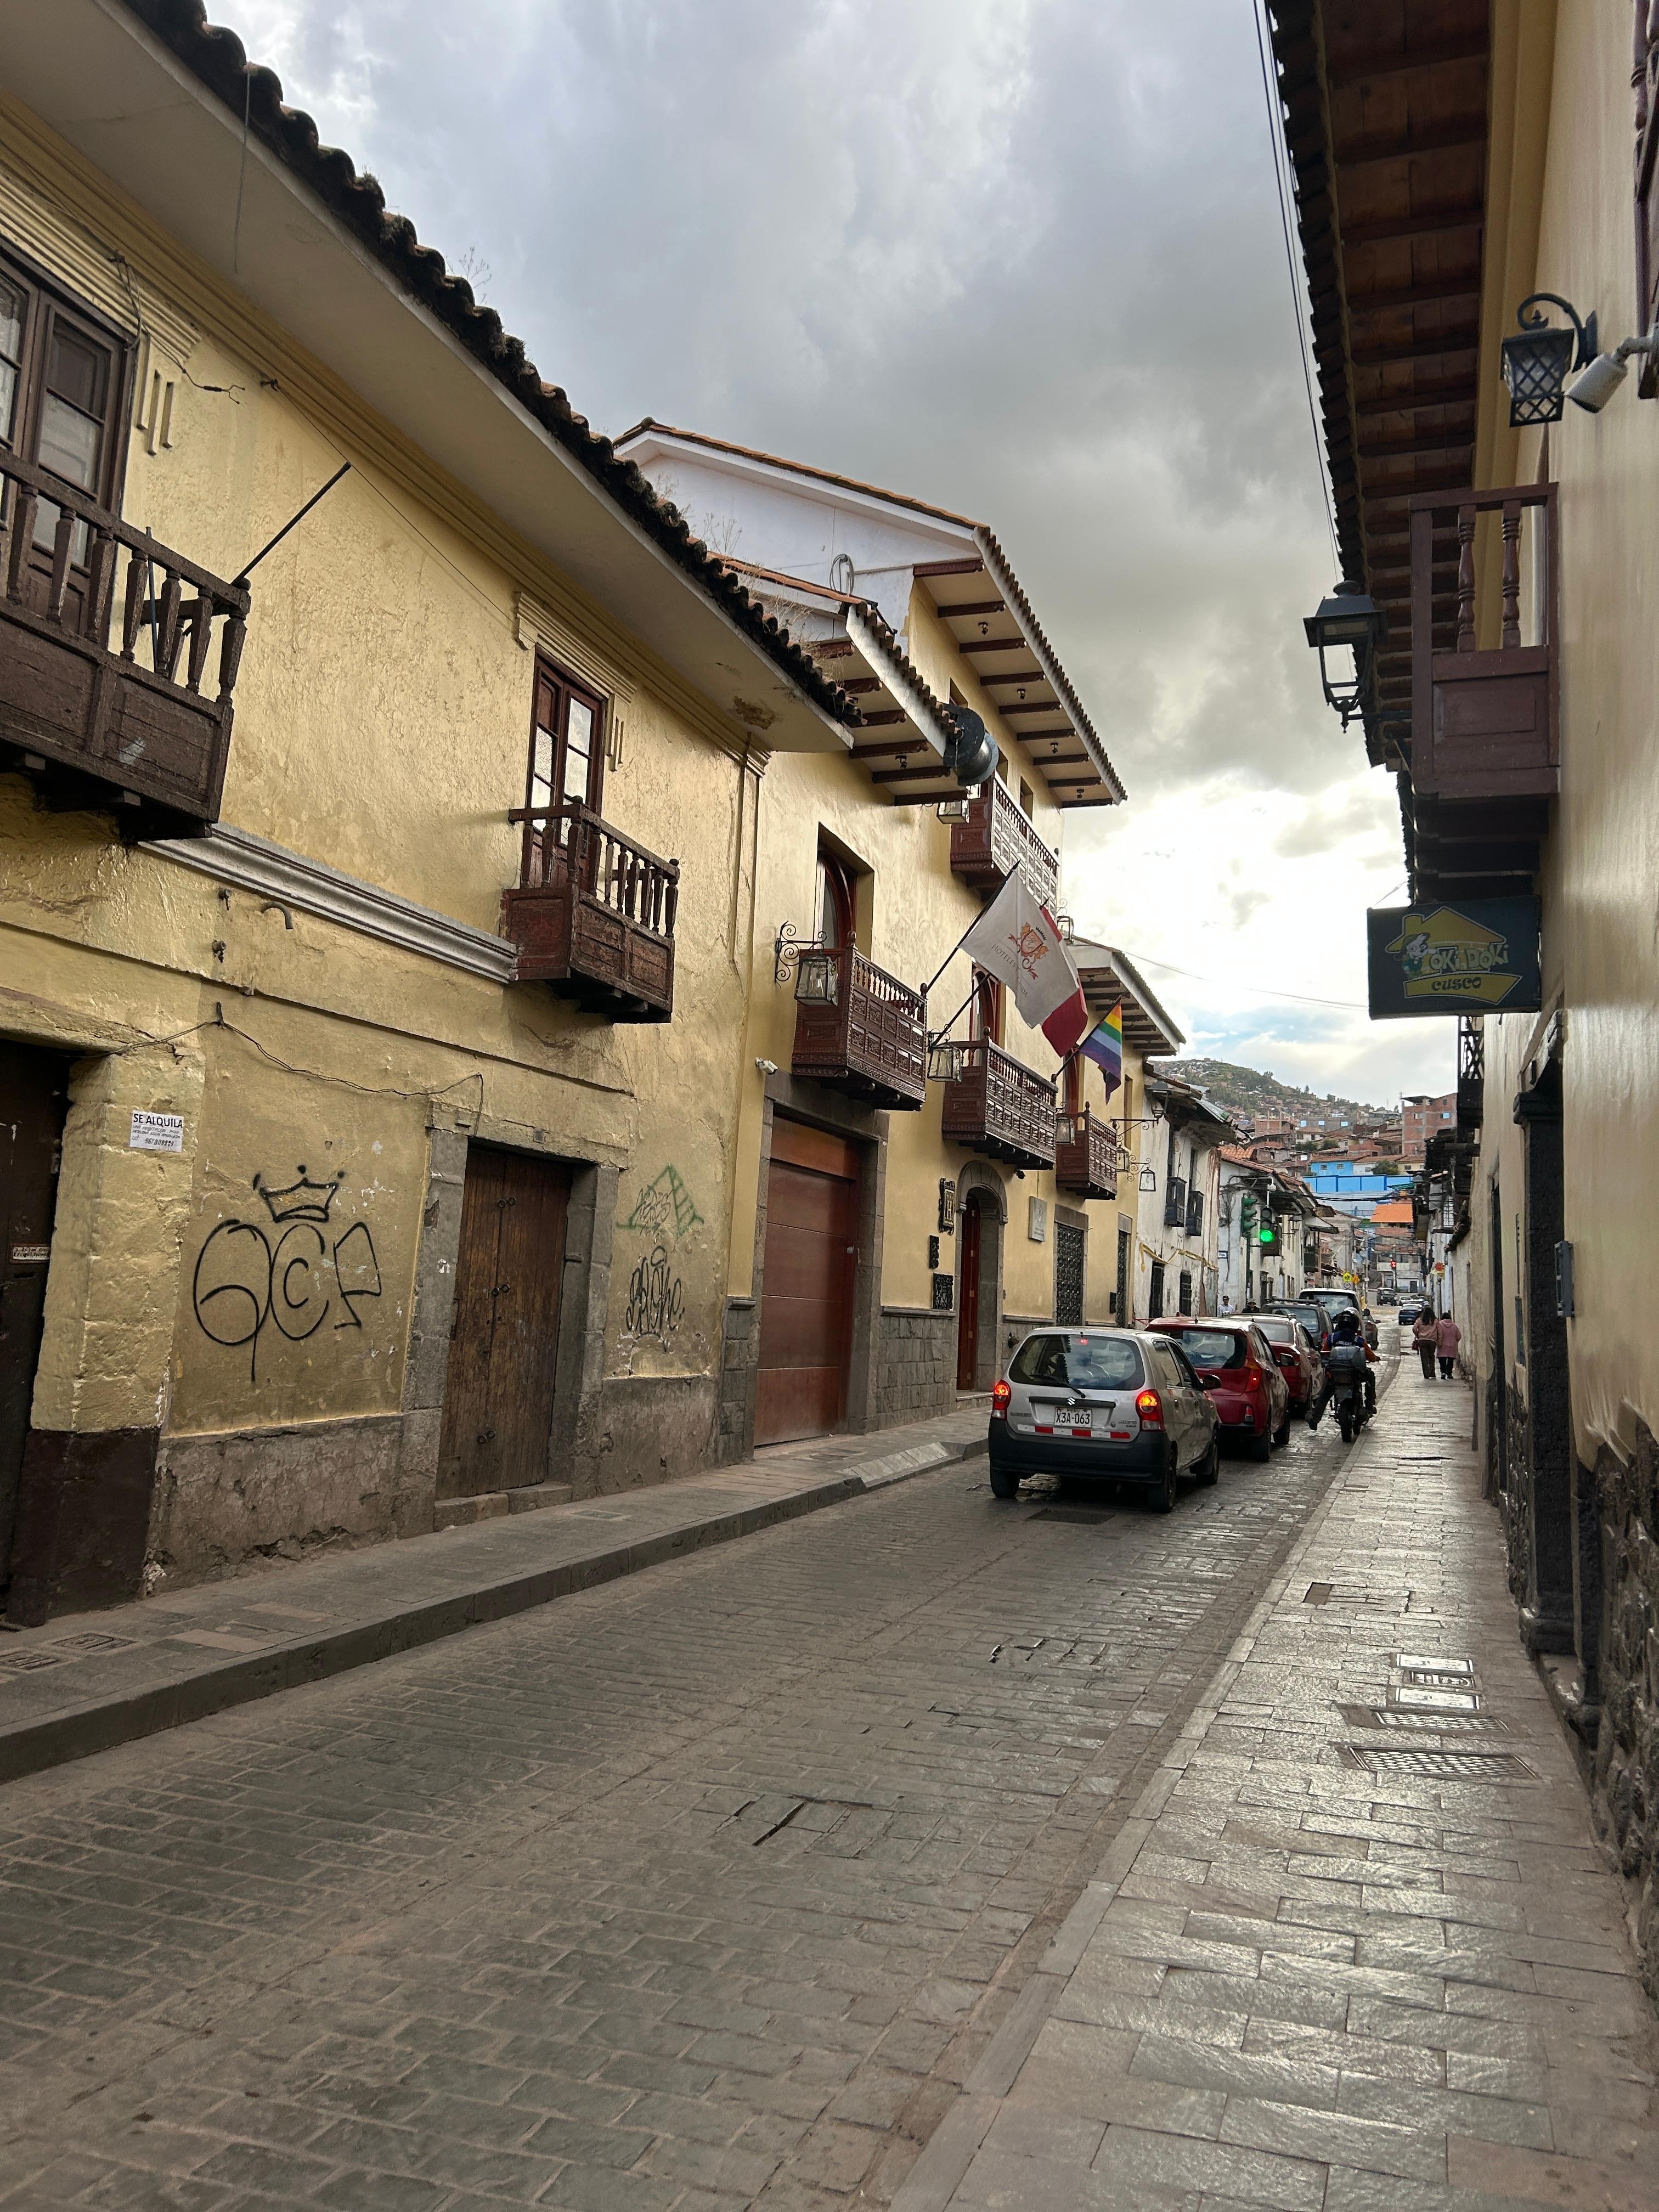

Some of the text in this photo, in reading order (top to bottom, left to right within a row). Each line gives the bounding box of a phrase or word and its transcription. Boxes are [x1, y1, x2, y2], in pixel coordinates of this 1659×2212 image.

[133, 1113, 183, 1128] SE ALQUILA
[1056, 1412, 1091, 1425] X3A-063
